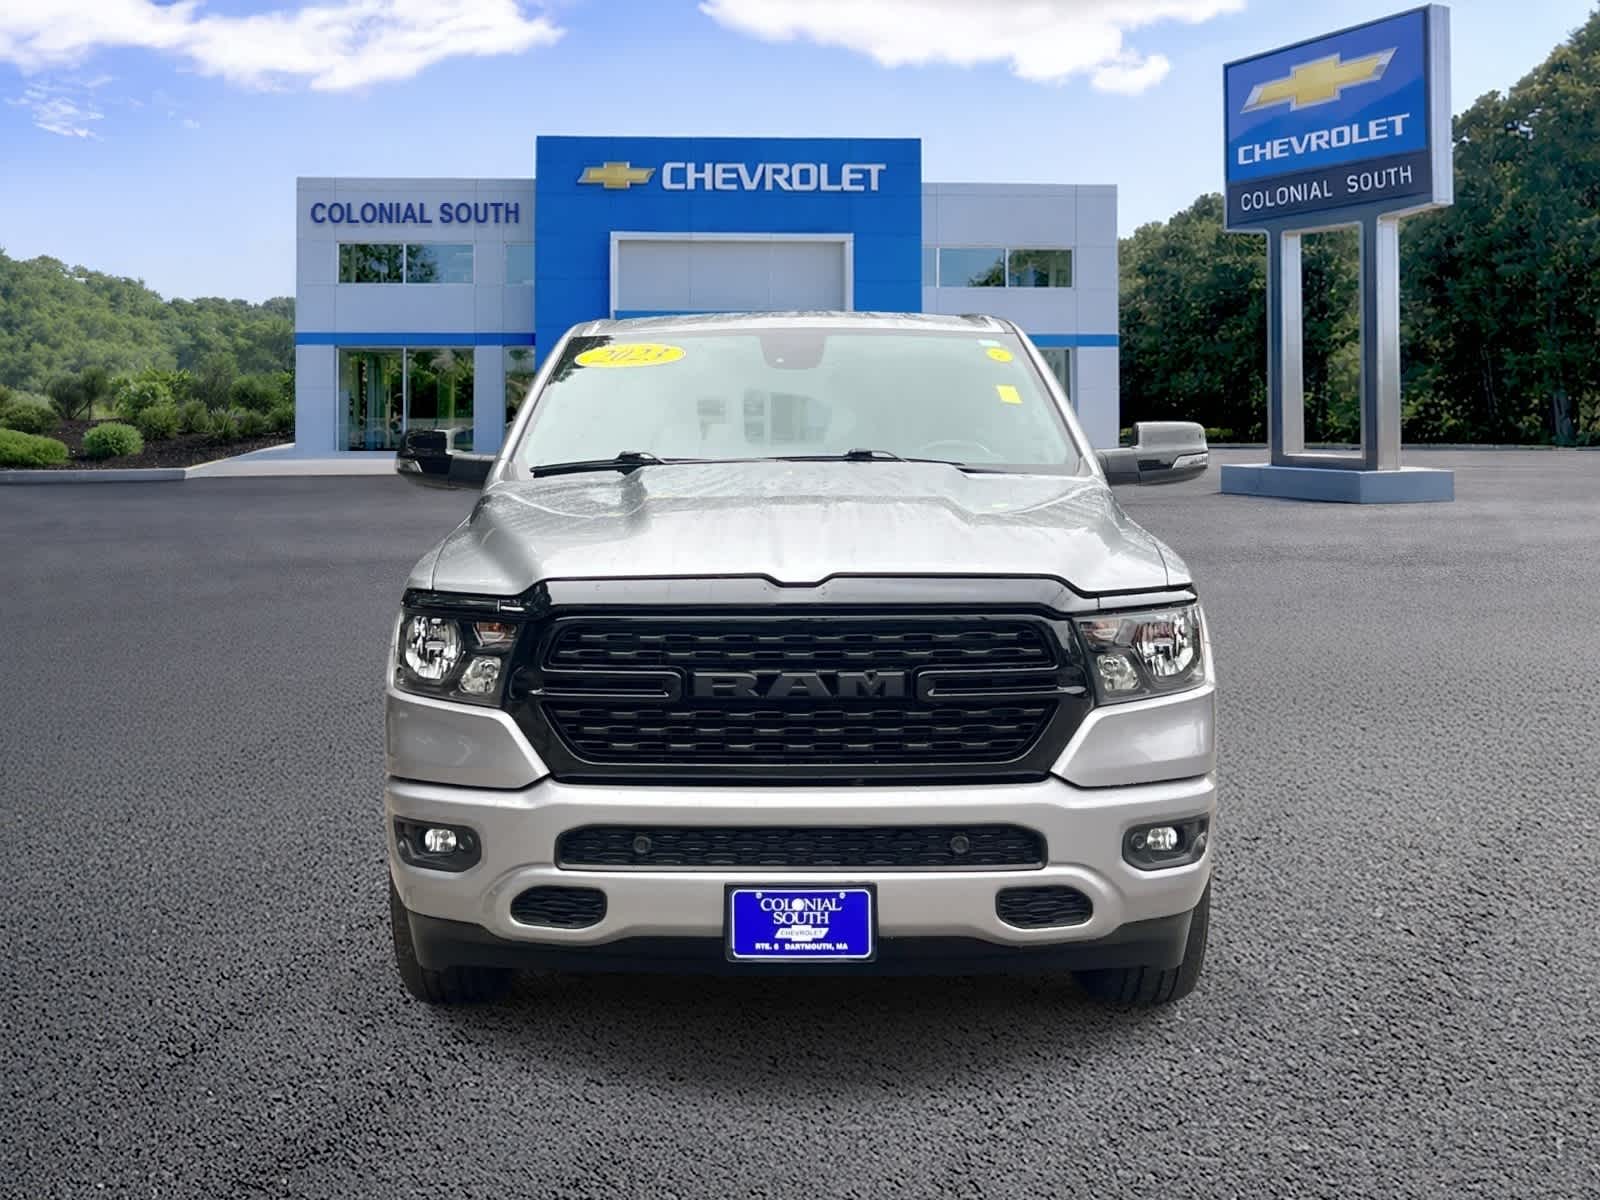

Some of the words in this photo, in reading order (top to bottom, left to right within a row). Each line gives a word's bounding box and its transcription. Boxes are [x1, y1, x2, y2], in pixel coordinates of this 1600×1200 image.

[1237, 113, 1411, 165] CHEVROLET
[661, 162, 887, 193] CHEVROLET
[1240, 179, 1333, 212] COLONIAL
[1346, 165, 1413, 194] SOUTH
[310, 202, 433, 225] COLONIAL
[438, 202, 521, 225] SOUTH
[694, 670, 905, 698] RAM
[760, 897, 843, 912] COLONIAL
[773, 911, 830, 925] SOUTH
[754, 942, 773, 951] RTE.
[784, 942, 835, 952] DARTMOUTH,
[835, 942, 849, 951] MA
